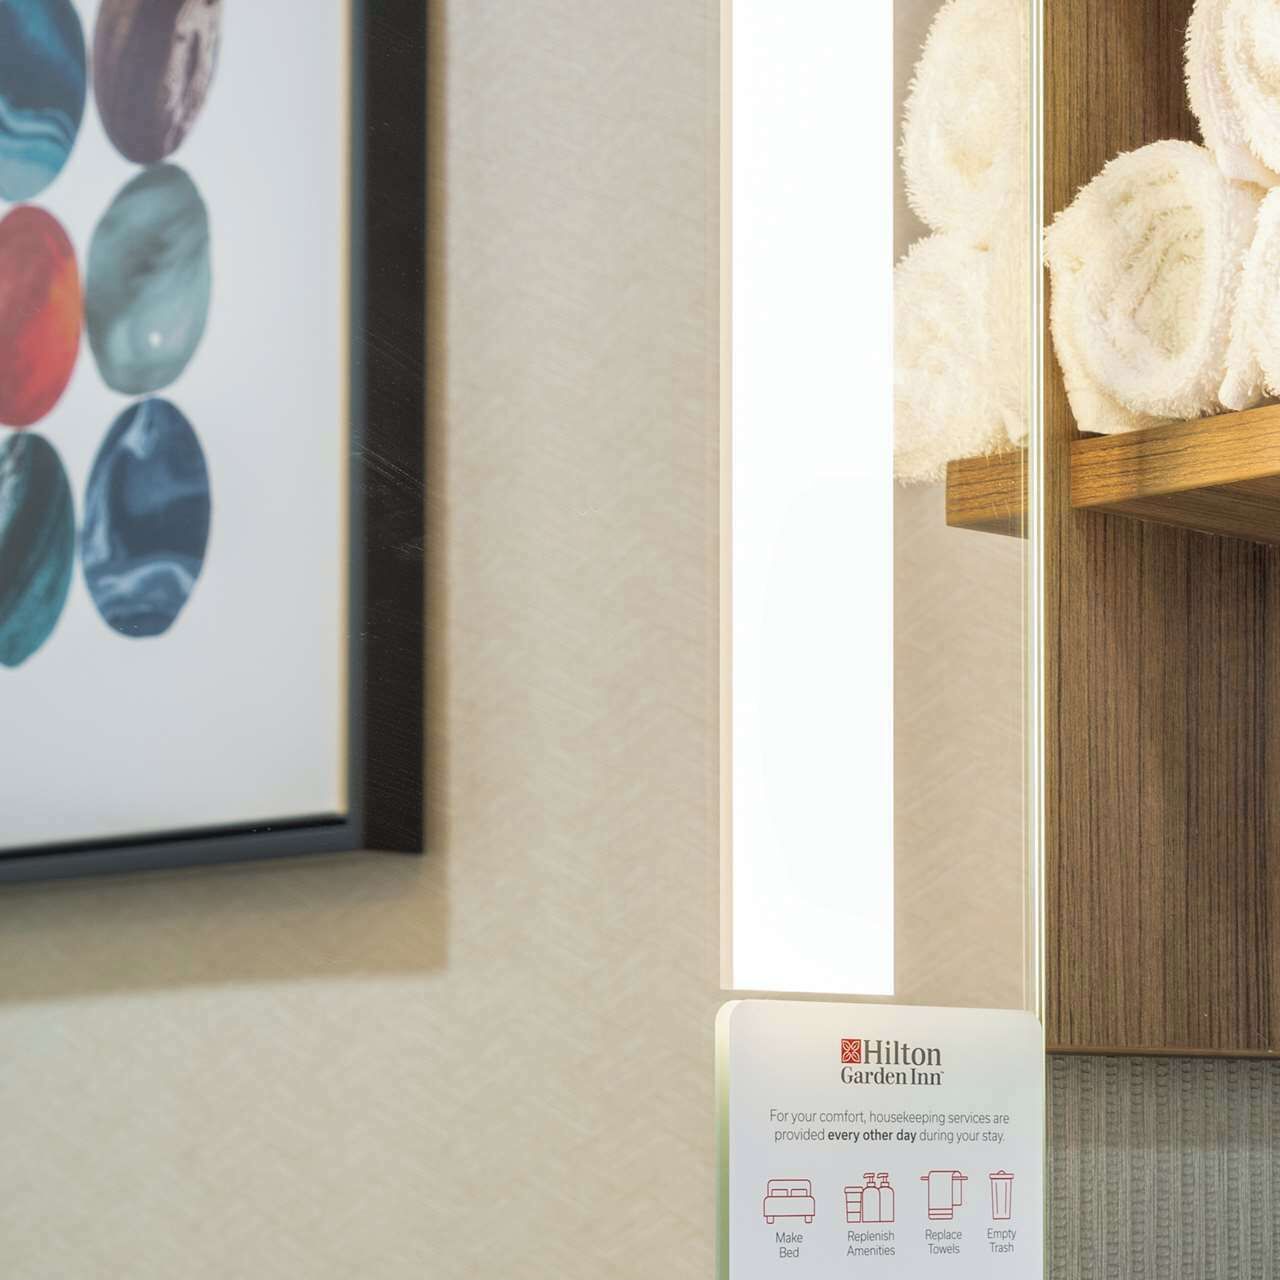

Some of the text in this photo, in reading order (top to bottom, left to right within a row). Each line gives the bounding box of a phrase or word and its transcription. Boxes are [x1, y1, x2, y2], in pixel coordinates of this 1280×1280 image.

[864, 1040, 942, 1065] Hilton
[841, 1066, 907, 1084] Garden
[770, 1109, 1009, 1125] For your comfort, housekeeping services are
[775, 1128, 1005, 1143] provided every other day during your stay.
[776, 1232, 803, 1243] Make
[848, 1231, 894, 1243] Replenish
[925, 1229, 962, 1241] Replace
[987, 1228, 1016, 1241] Empty
[779, 1247, 799, 1258] Bed
[847, 1245, 895, 1256] Amenities
[928, 1243, 960, 1254] Towels
[990, 1242, 1014, 1253] Trash
